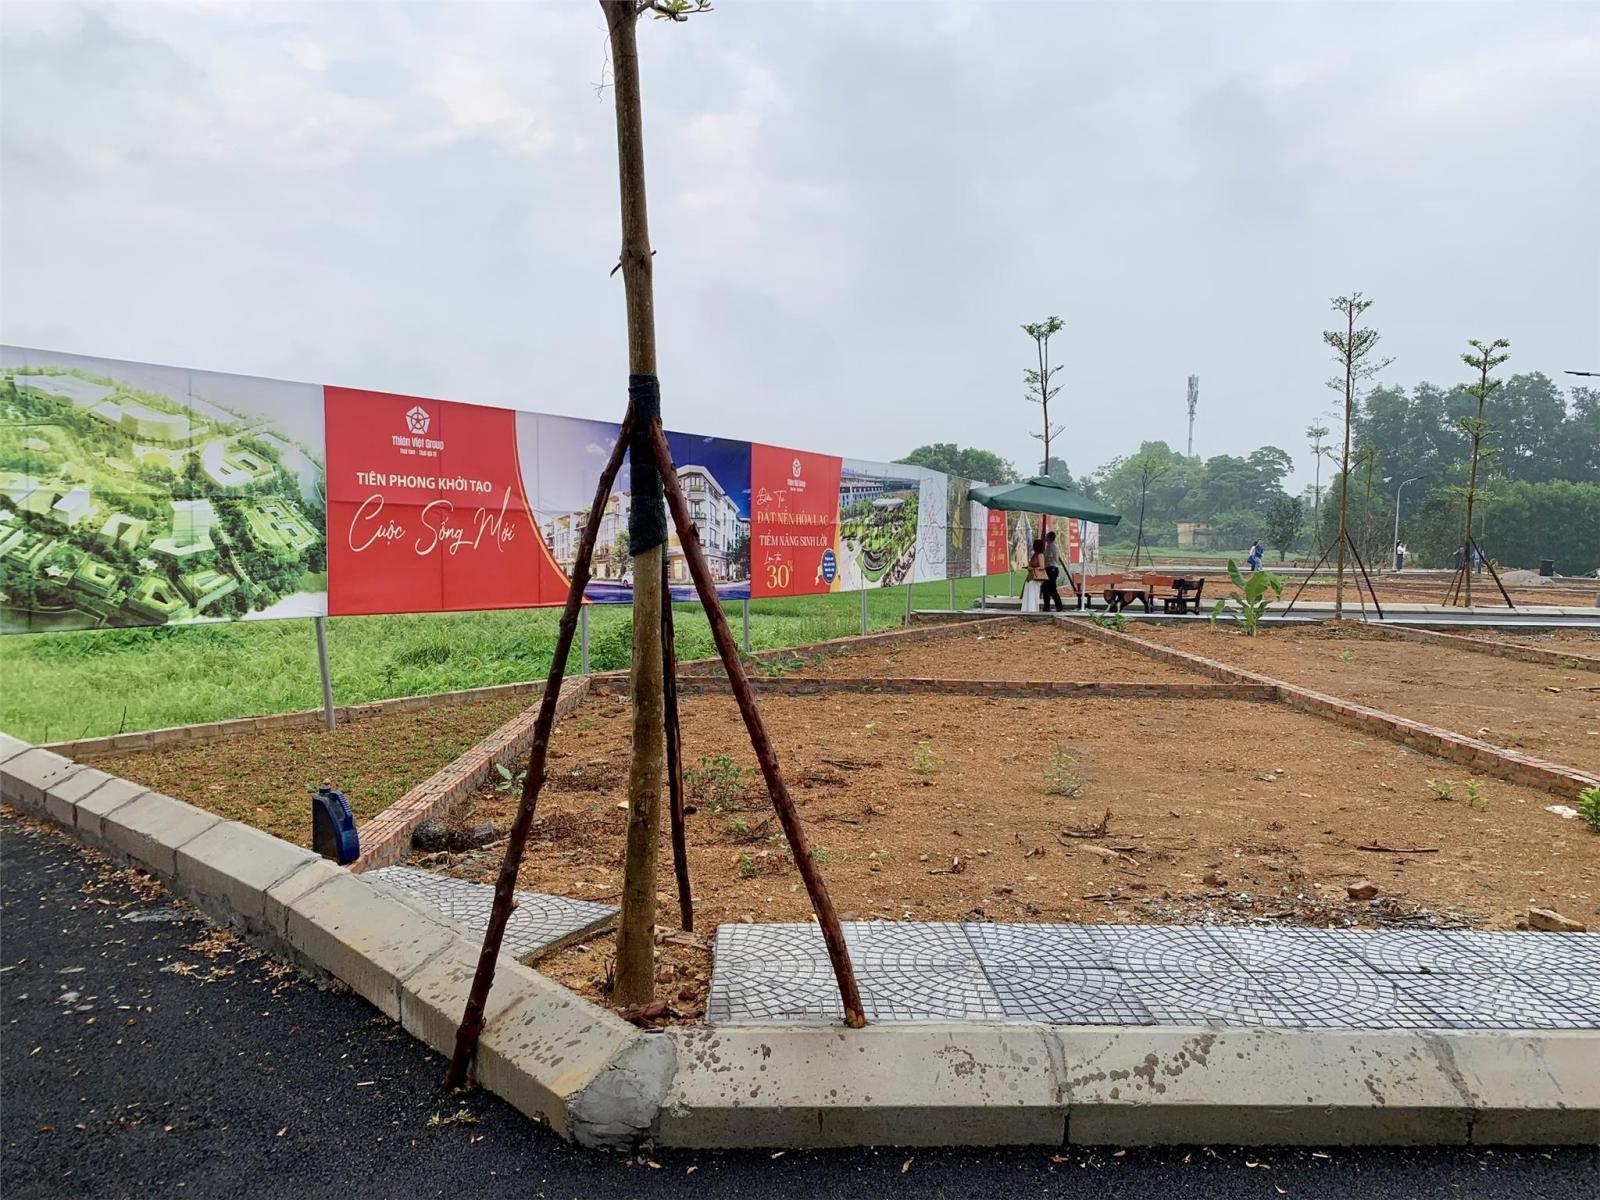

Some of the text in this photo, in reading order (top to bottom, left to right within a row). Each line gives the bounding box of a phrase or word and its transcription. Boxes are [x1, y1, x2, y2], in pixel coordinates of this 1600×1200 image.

[411, 437, 424, 449] Việt
[425, 439, 445, 450] Group
[356, 470, 492, 495] TIÊN PHONG KHỞI TẠO
[349, 485, 516, 556] Cuộc Sống Mới
[799, 535, 815, 547] SINH
